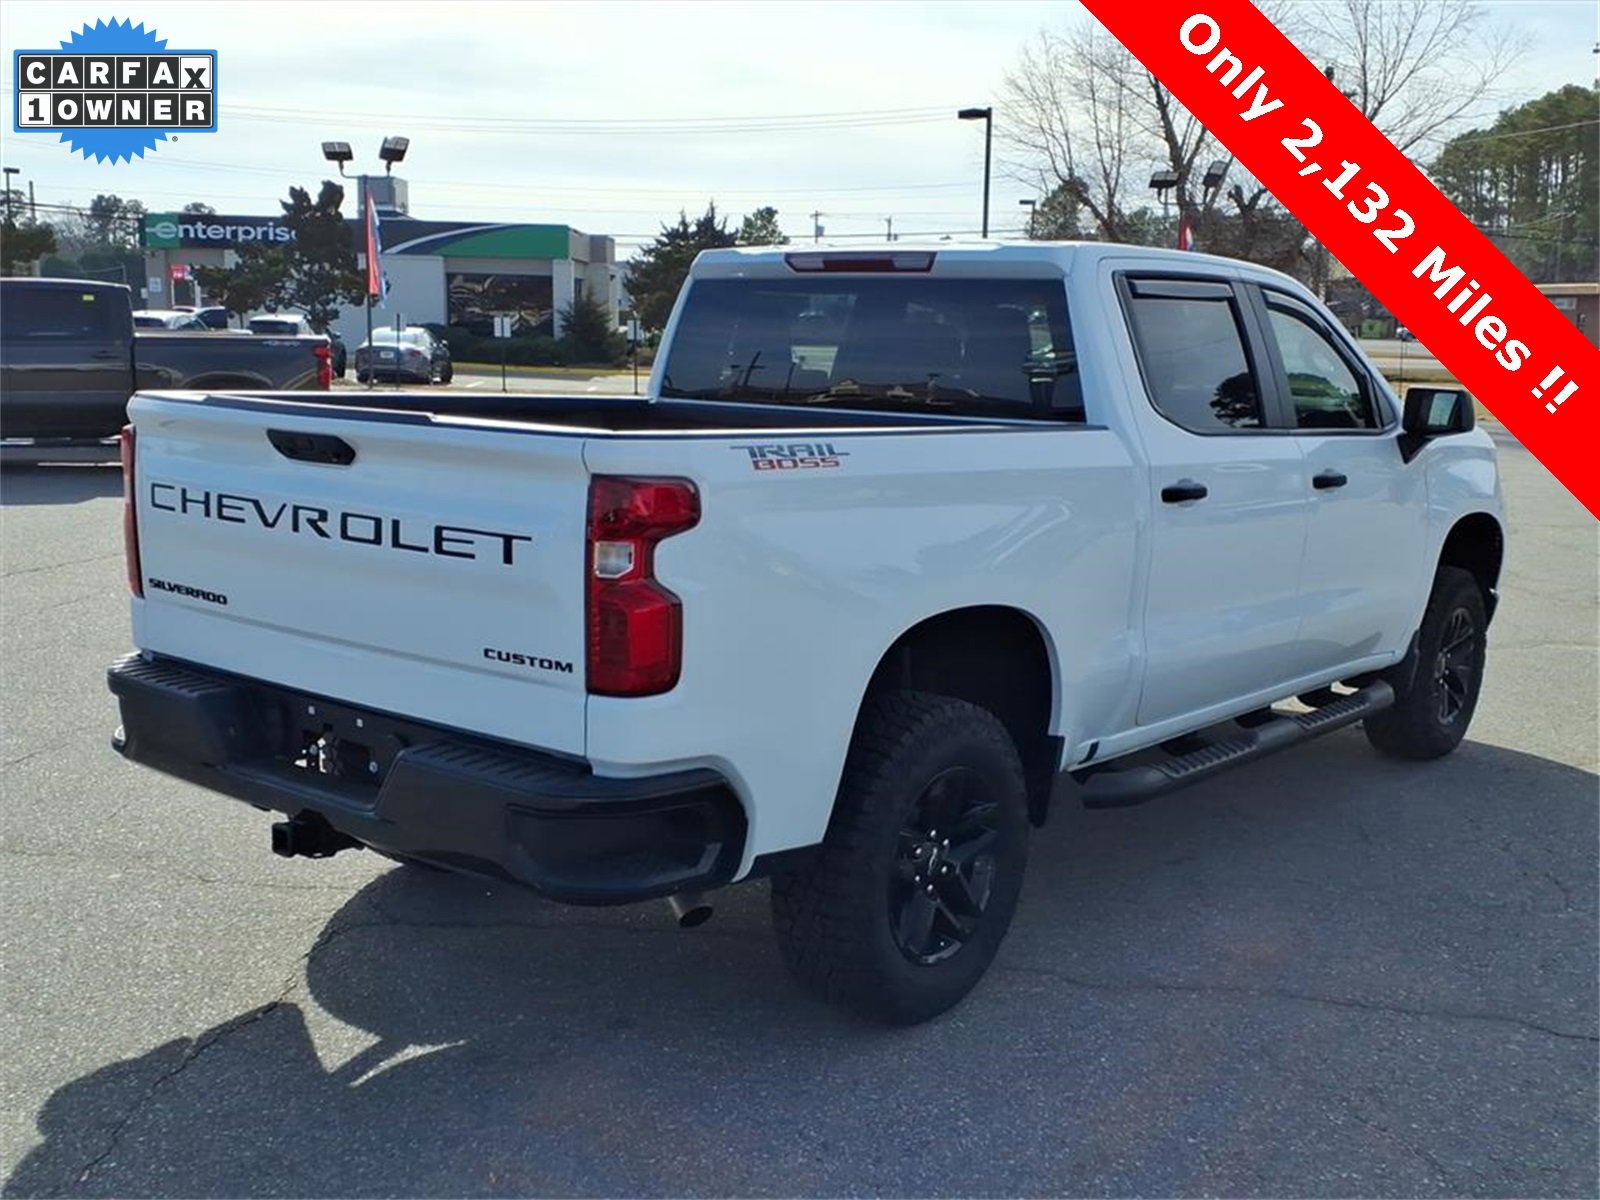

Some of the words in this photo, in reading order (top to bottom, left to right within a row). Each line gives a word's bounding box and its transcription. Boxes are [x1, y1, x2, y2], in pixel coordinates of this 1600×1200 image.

[730, 443, 850, 458] TRAIL
[752, 457, 840, 470] BOSS
[150, 483, 533, 565] CHEVROLET
[148, 578, 228, 605] SILVERADO
[483, 648, 573, 674] CUSTOM
